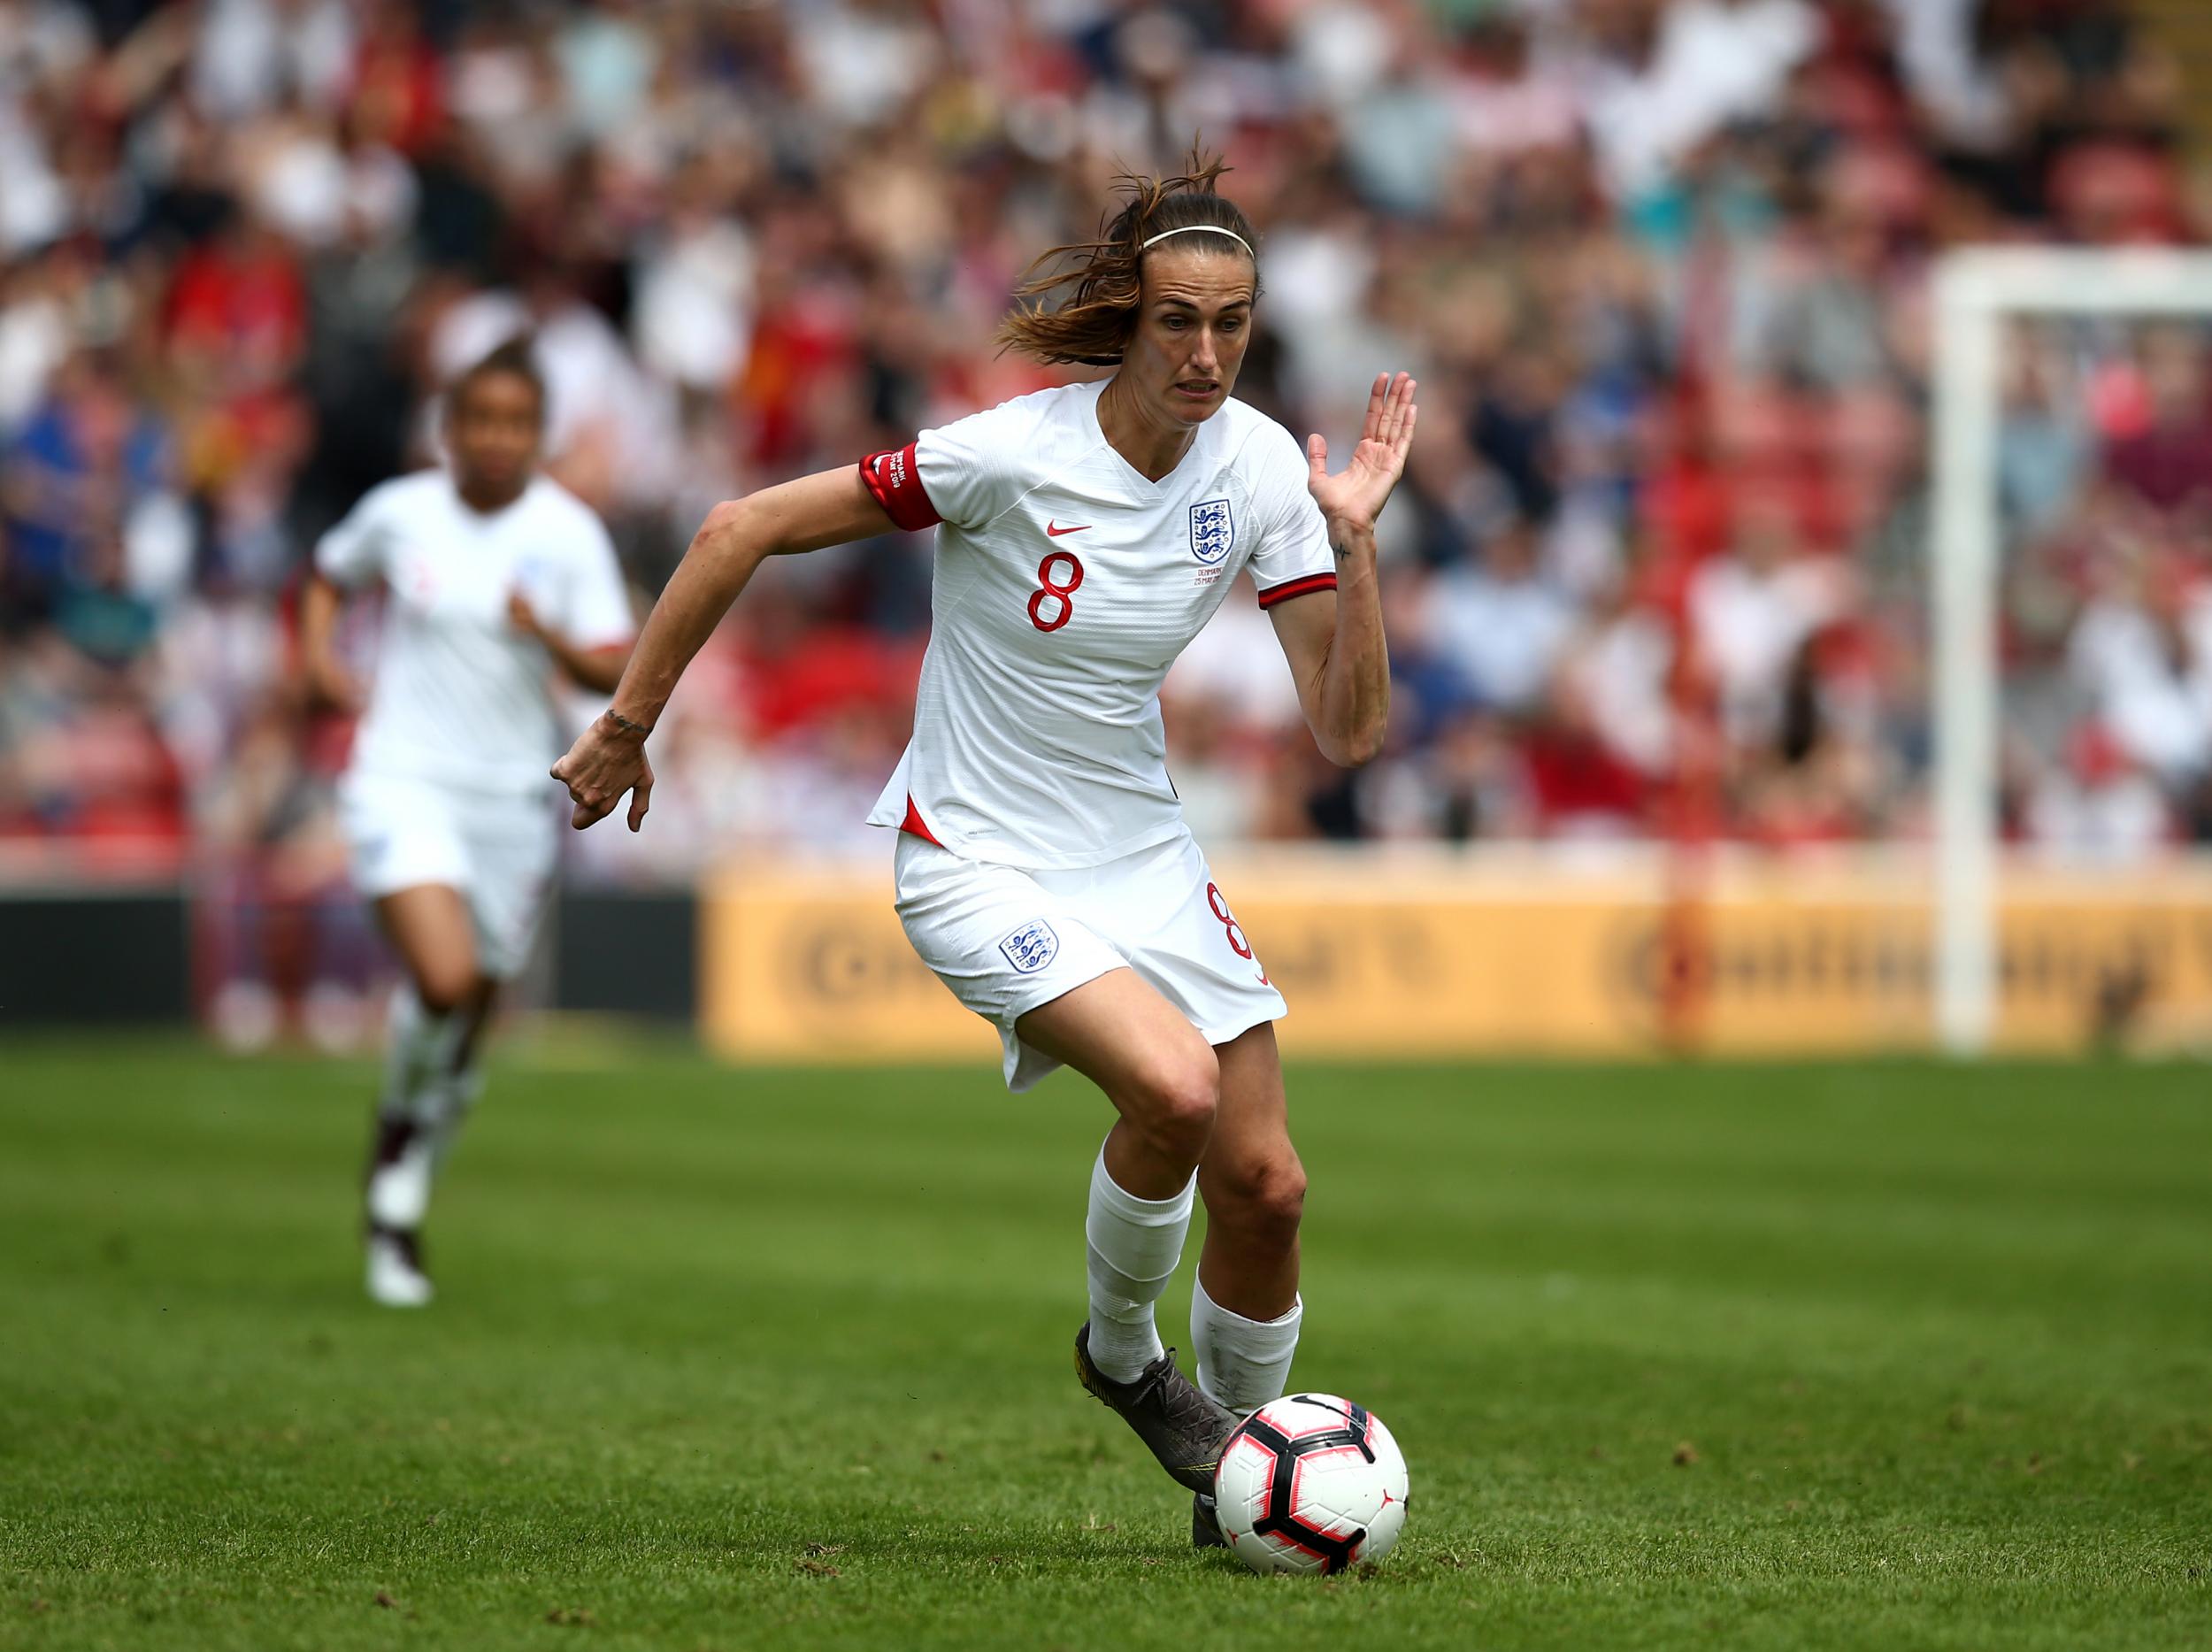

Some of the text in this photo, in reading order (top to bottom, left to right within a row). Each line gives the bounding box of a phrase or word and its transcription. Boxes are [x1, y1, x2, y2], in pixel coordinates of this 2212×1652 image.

[890, 472, 901, 488] 2019
[1027, 551, 1084, 633] 8
[1207, 882, 1252, 960] 8
